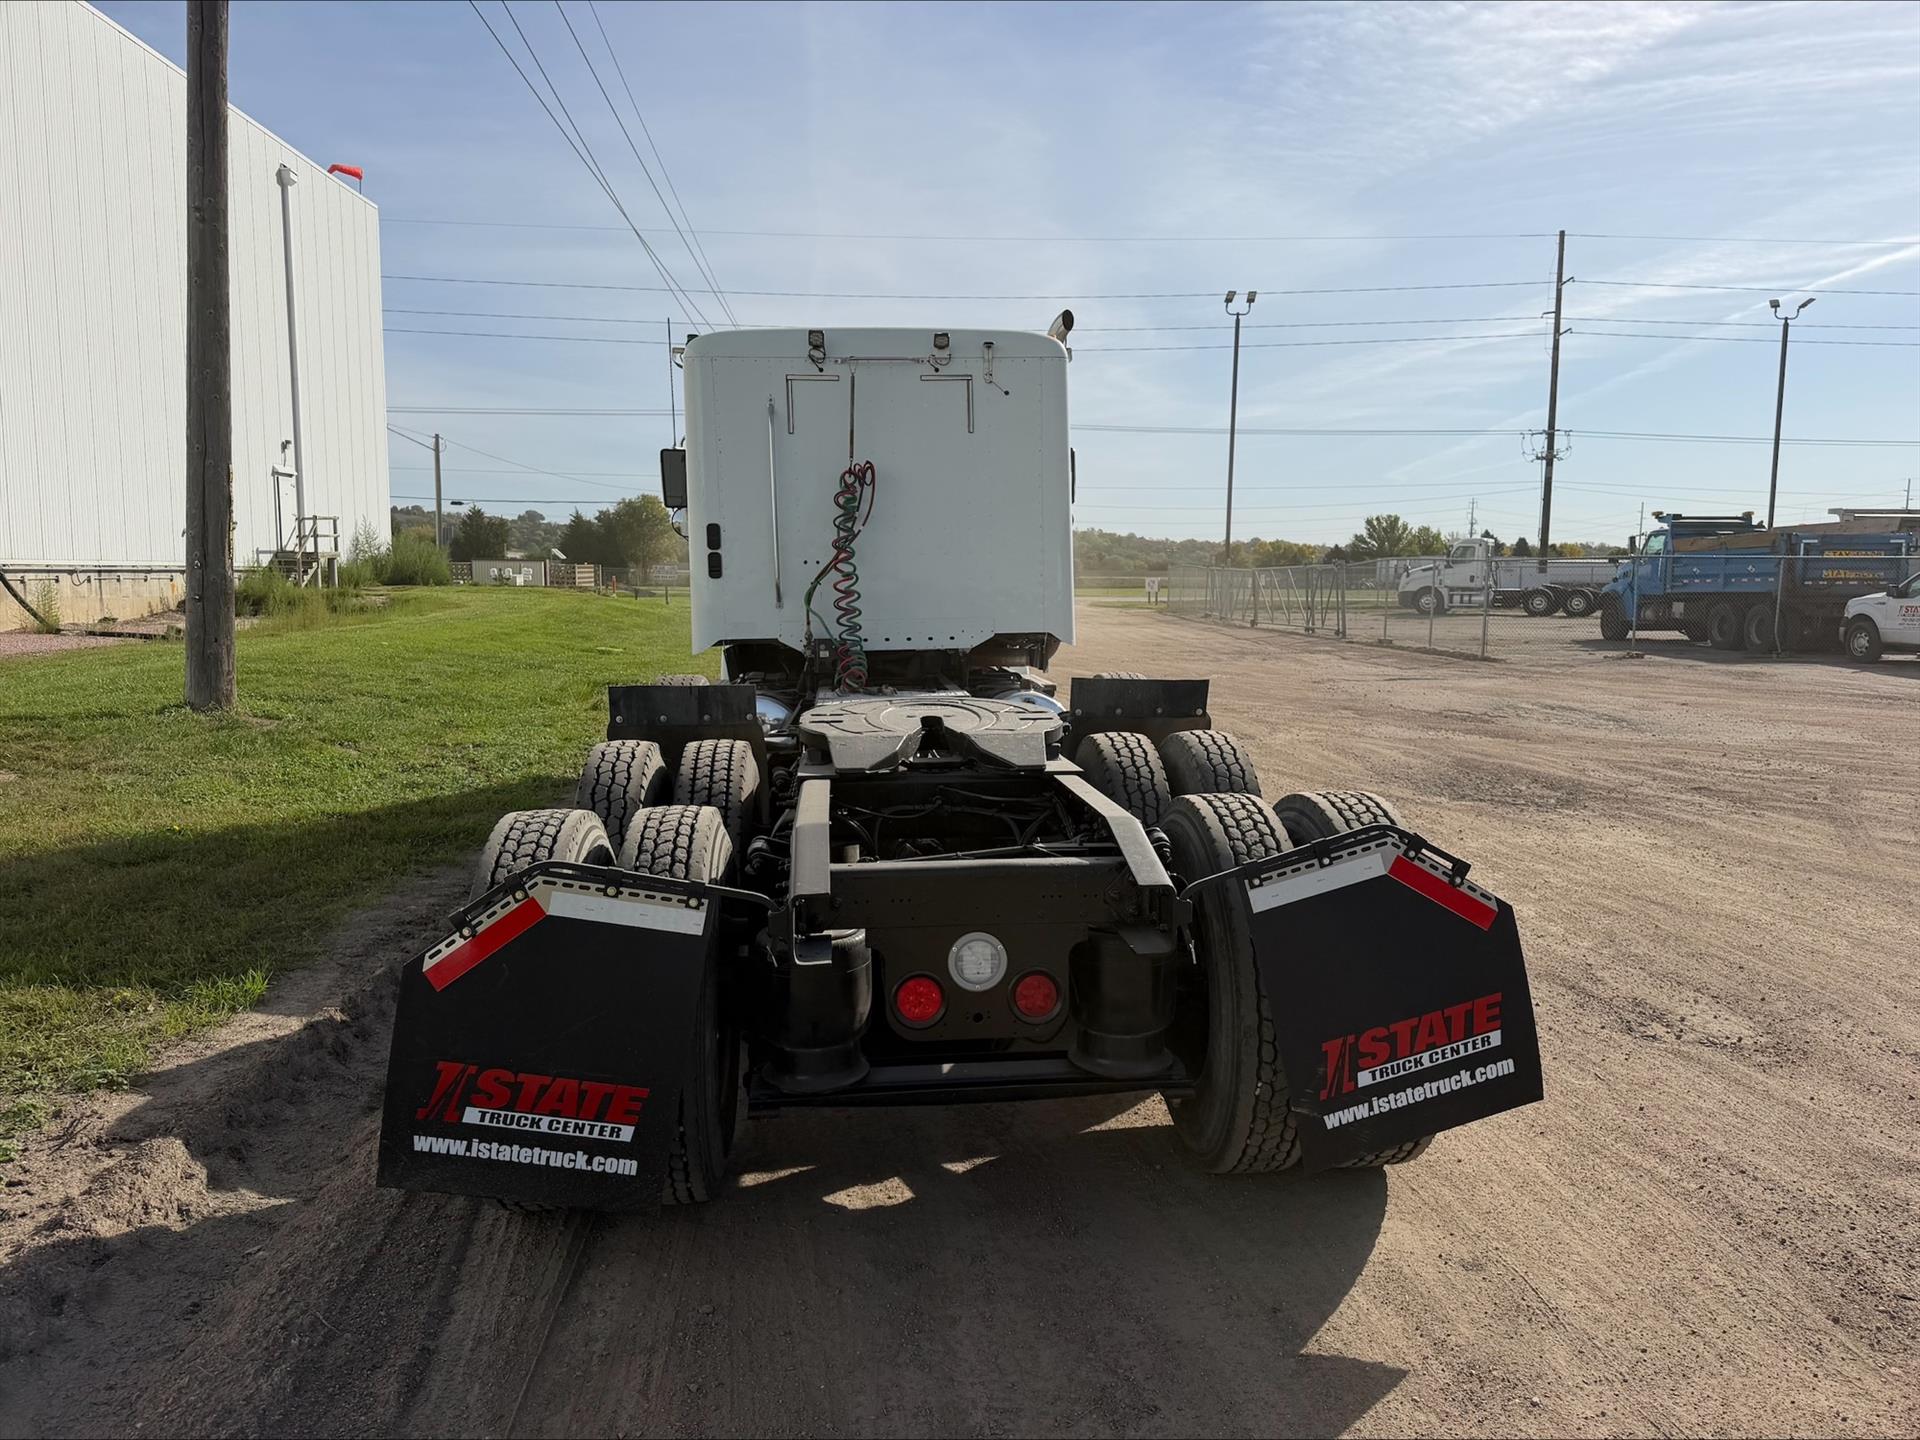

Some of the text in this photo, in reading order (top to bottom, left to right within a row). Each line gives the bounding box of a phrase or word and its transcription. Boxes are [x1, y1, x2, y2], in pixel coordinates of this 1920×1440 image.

[1368, 1034, 1492, 1082] TRUCK CENTER
[1323, 1058, 1516, 1130] www.istatetruck.com
[477, 1110, 622, 1139] TRUCK CENTER
[413, 1134, 639, 1177] www.istatetruck.com
